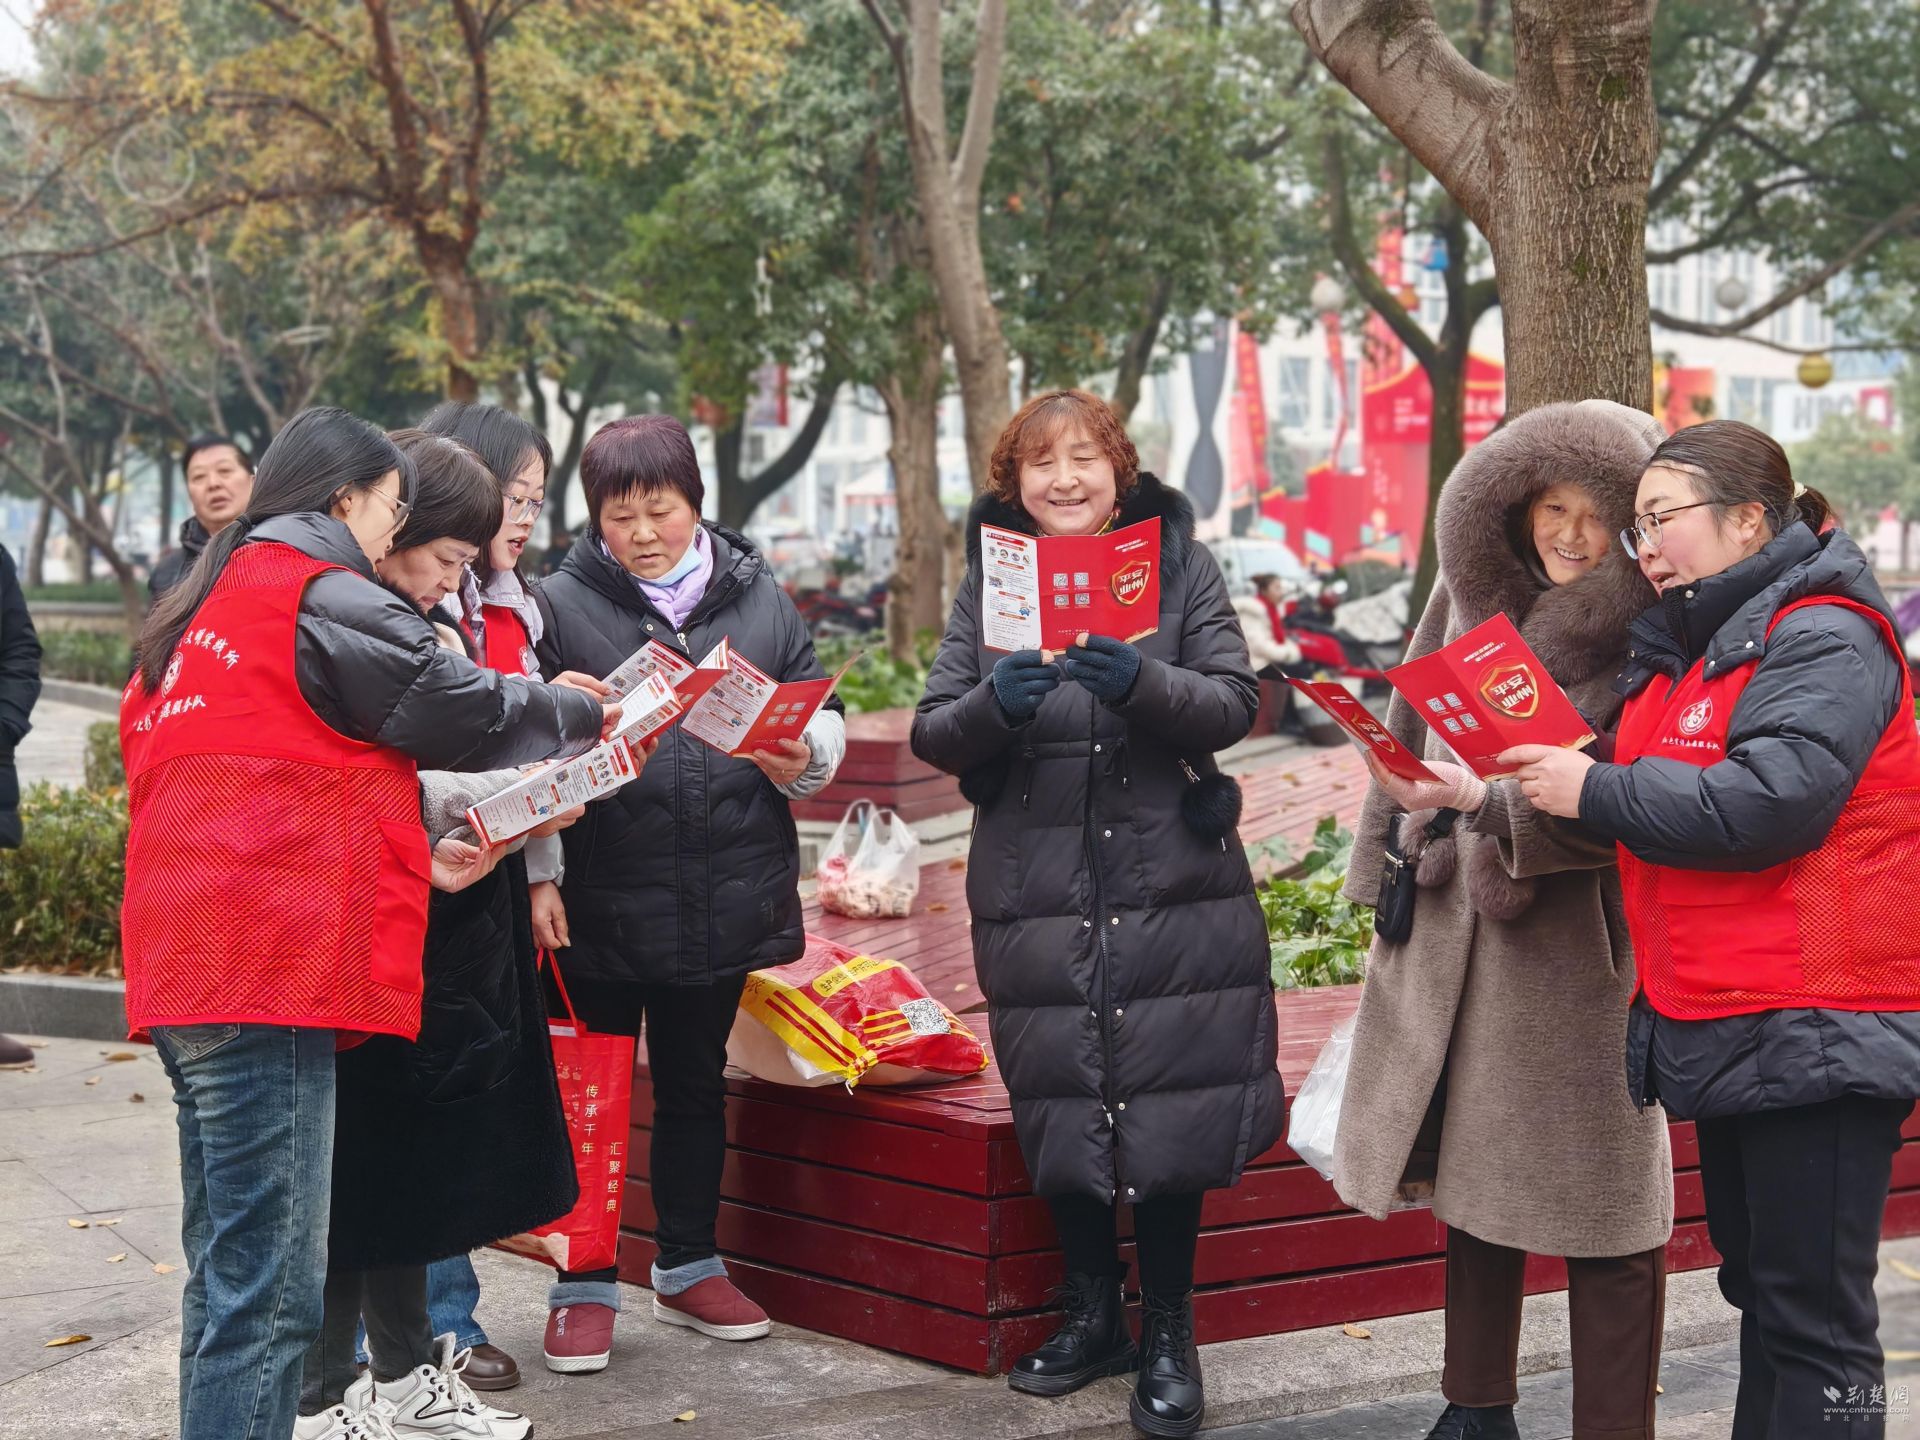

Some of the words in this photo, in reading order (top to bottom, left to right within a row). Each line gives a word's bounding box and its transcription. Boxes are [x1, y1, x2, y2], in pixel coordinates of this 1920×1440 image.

[179, 628, 240, 670] 文明实践所
[1489, 673, 1526, 696] 平安
[581, 1084, 599, 1156] 传承千年
[605, 1141, 623, 1213] 汇聚经典
